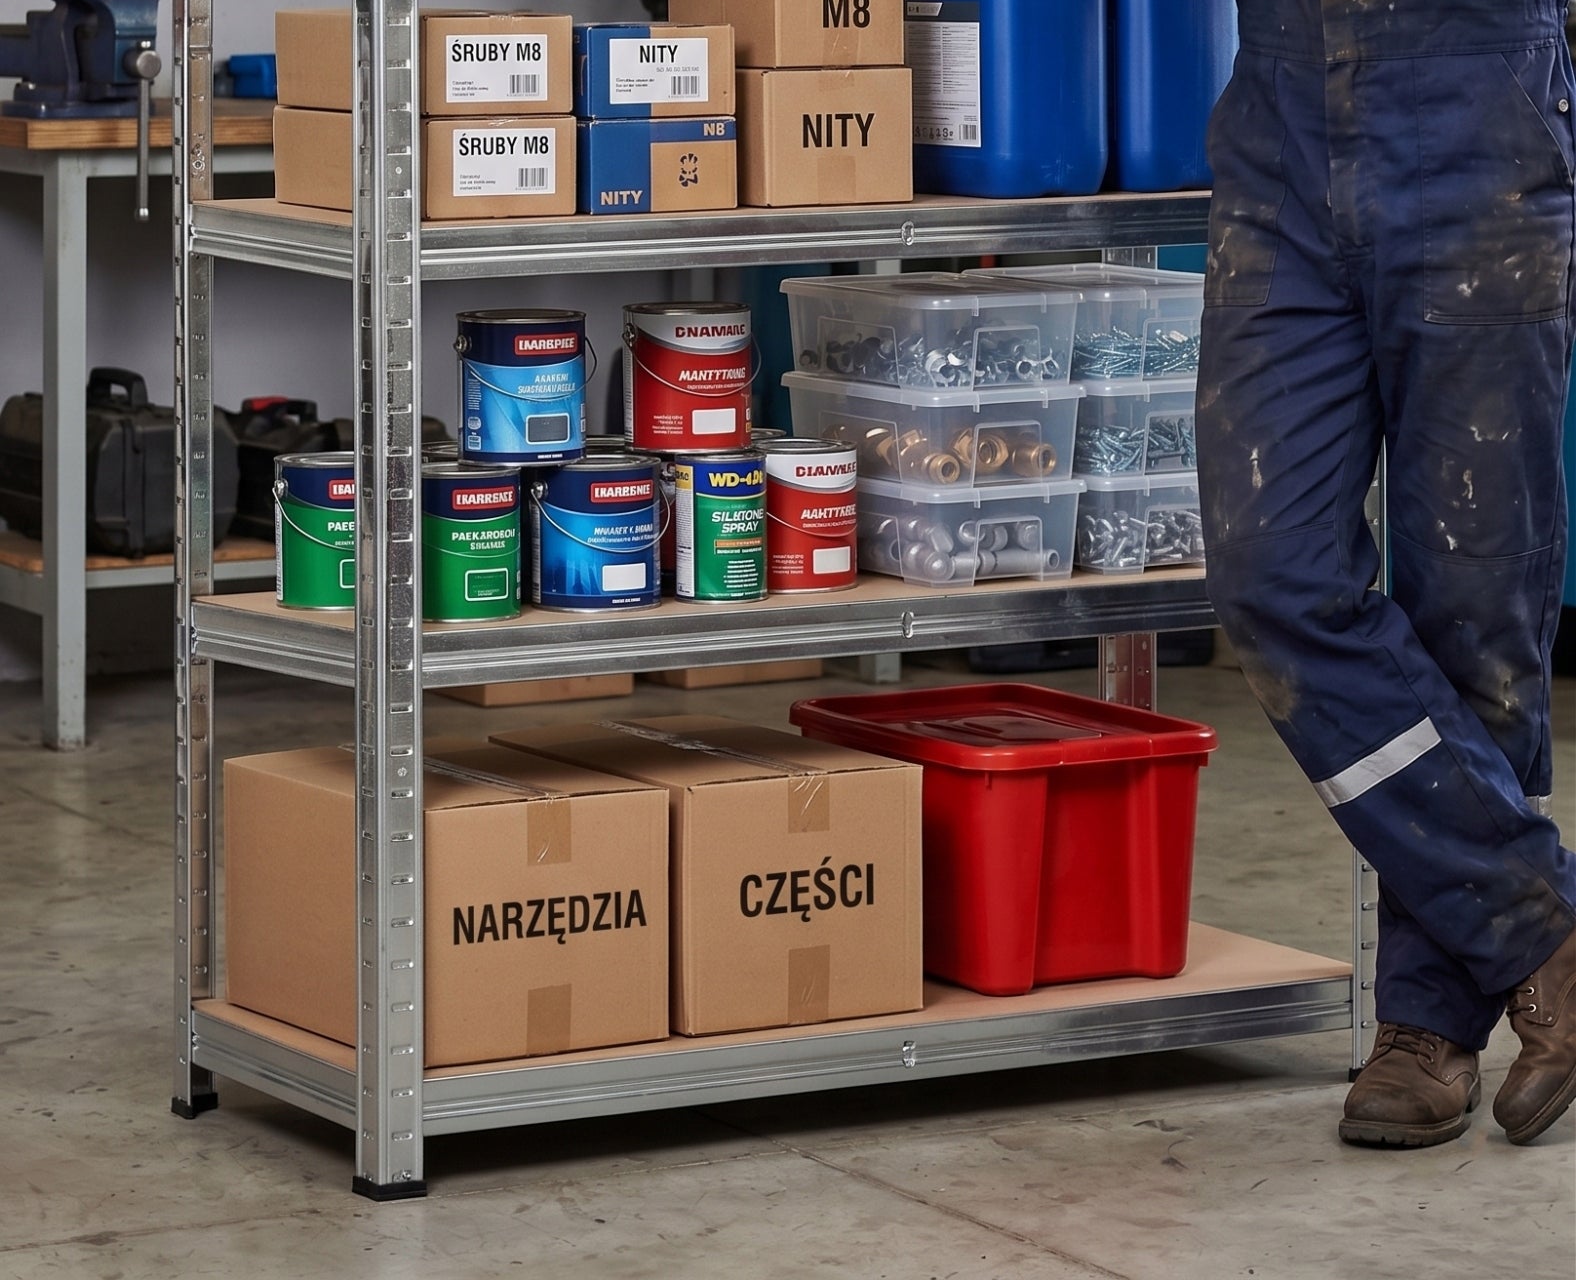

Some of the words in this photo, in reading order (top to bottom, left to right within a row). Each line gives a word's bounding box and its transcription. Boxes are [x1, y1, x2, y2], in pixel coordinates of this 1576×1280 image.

[451, 39, 511, 63] ŚRUBY
[516, 42, 542, 62] M8
[639, 44, 679, 64] NITY
[703, 122, 726, 137] NB
[802, 112, 875, 149] NITY
[458, 133, 518, 157] ŚRUBY
[524, 135, 550, 156] M8
[600, 189, 643, 206] NITY
[721, 521, 759, 534] SPRAY
[739, 856, 875, 923] CZĘŚCI
[452, 889, 648, 945] NARZĘDZIA
